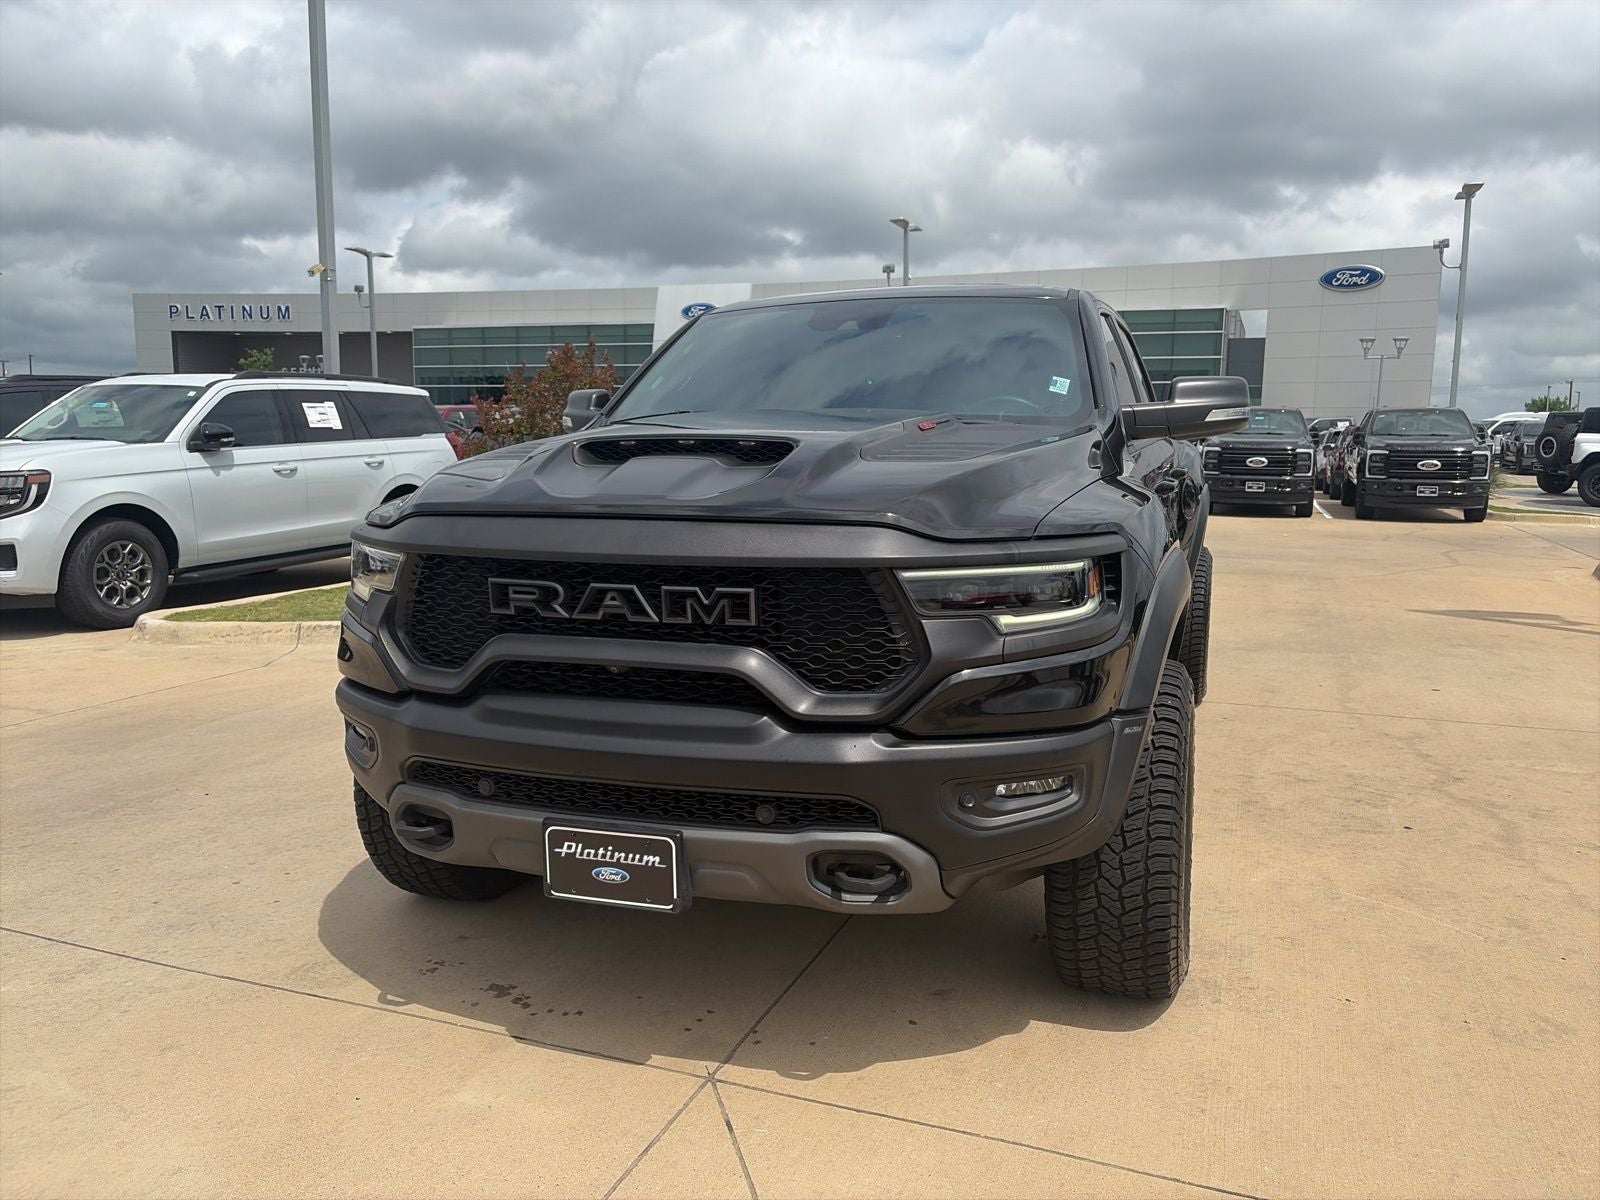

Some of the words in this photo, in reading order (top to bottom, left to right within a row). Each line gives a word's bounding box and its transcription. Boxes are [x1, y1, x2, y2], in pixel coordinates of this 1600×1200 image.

[1332, 270, 1370, 286] Ford
[168, 304, 292, 321] PLATINUM
[488, 577, 758, 626] RAM
[554, 841, 667, 868] Platinum
[599, 868, 622, 881] Ford
